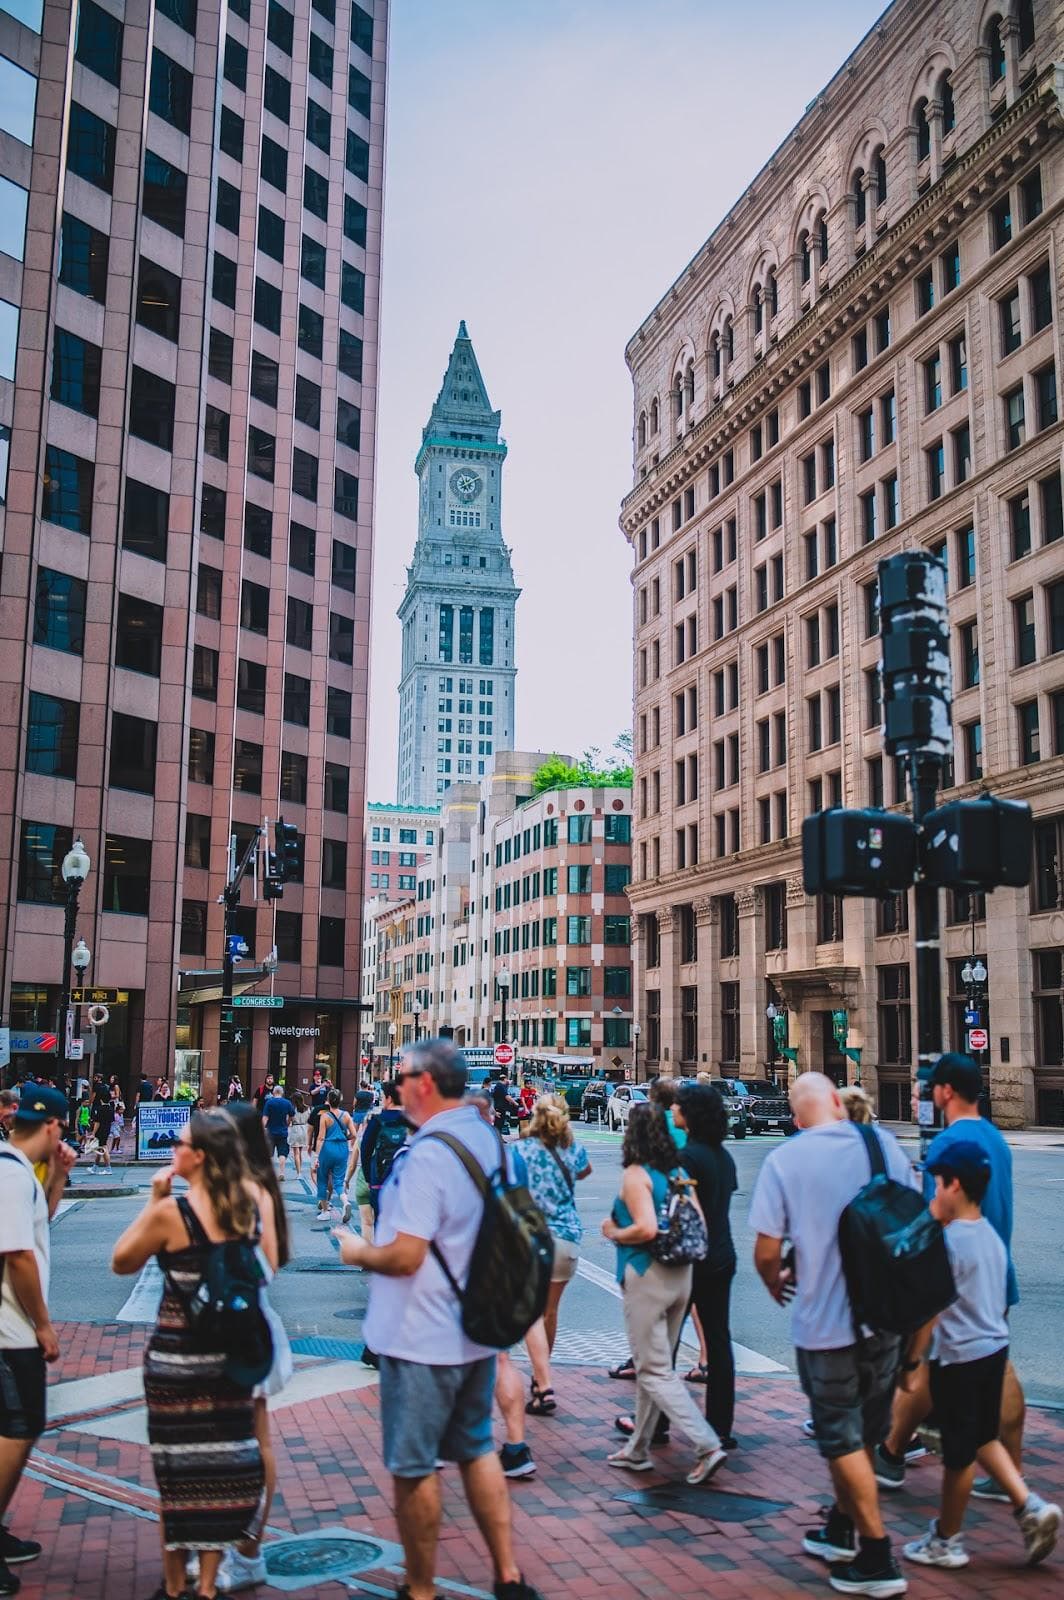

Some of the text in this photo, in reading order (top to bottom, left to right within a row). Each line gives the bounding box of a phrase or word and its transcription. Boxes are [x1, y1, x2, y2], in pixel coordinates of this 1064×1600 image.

[241, 998, 275, 1006] CONGRESS
[269, 1026, 320, 1038] sweetgreen
[158, 1112, 188, 1123] YOURSELF
